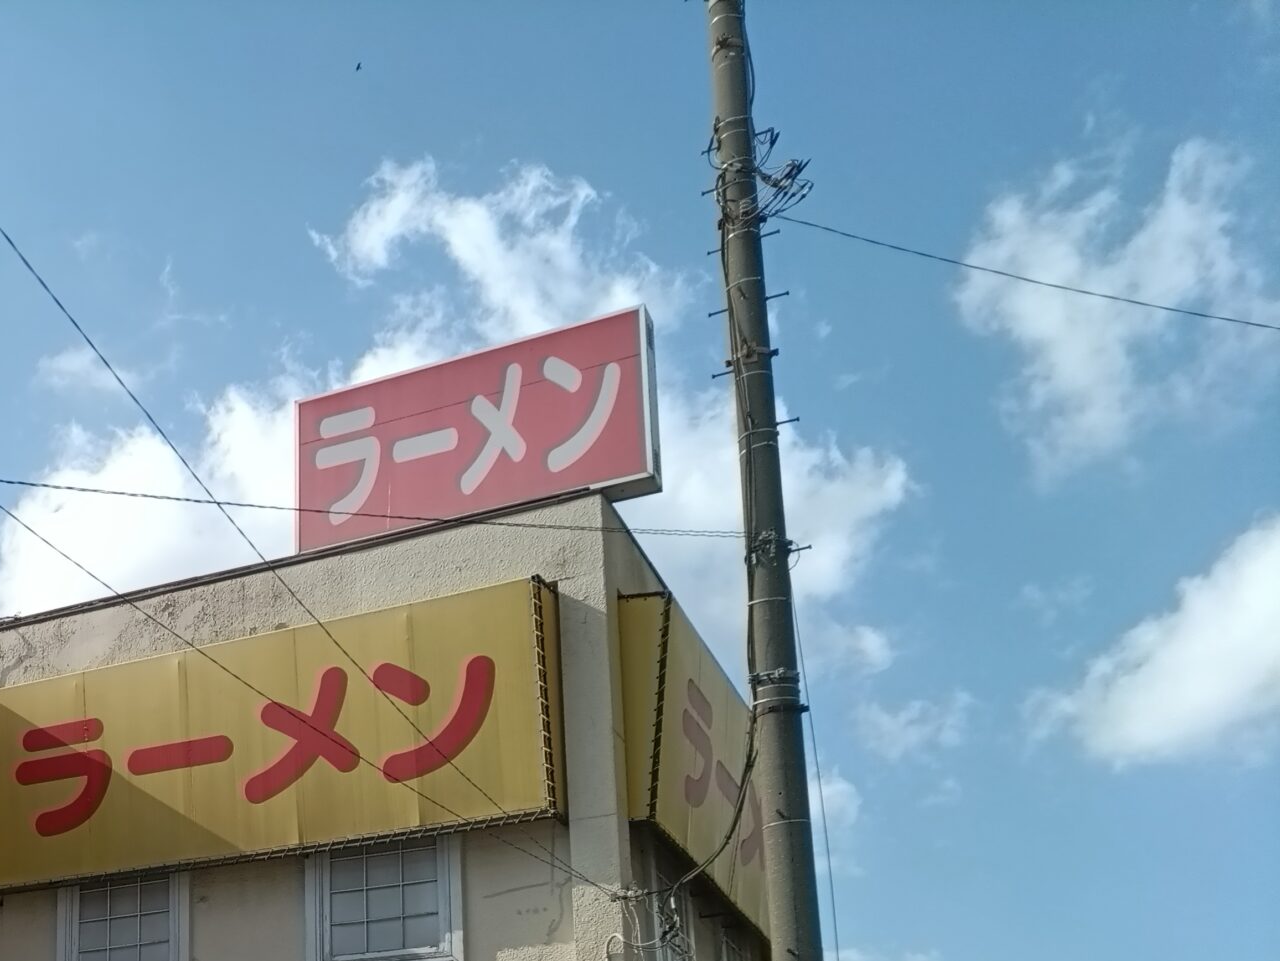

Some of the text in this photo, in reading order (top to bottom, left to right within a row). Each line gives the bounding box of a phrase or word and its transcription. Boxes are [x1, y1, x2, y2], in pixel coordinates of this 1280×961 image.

[315, 355, 622, 526] ラーメン
[14, 654, 497, 838] ラーメン
